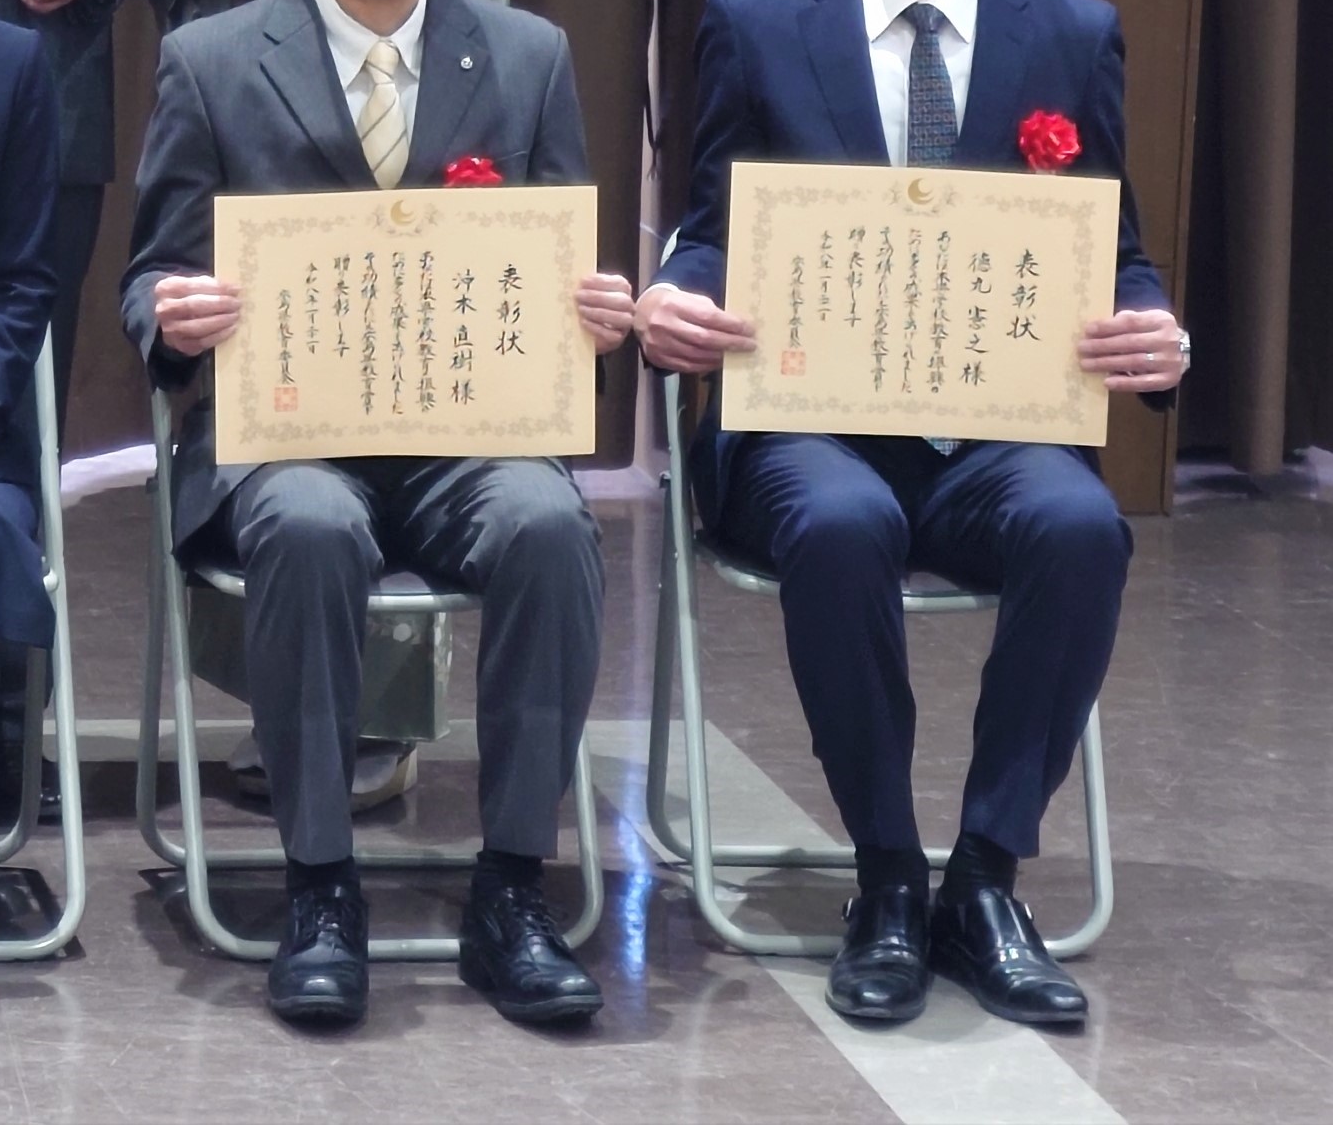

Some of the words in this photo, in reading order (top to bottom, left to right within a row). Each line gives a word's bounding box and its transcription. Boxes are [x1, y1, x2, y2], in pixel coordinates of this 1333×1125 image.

[494, 263, 526, 356] 表彰状
[1005, 248, 1042, 342] 表彰状
